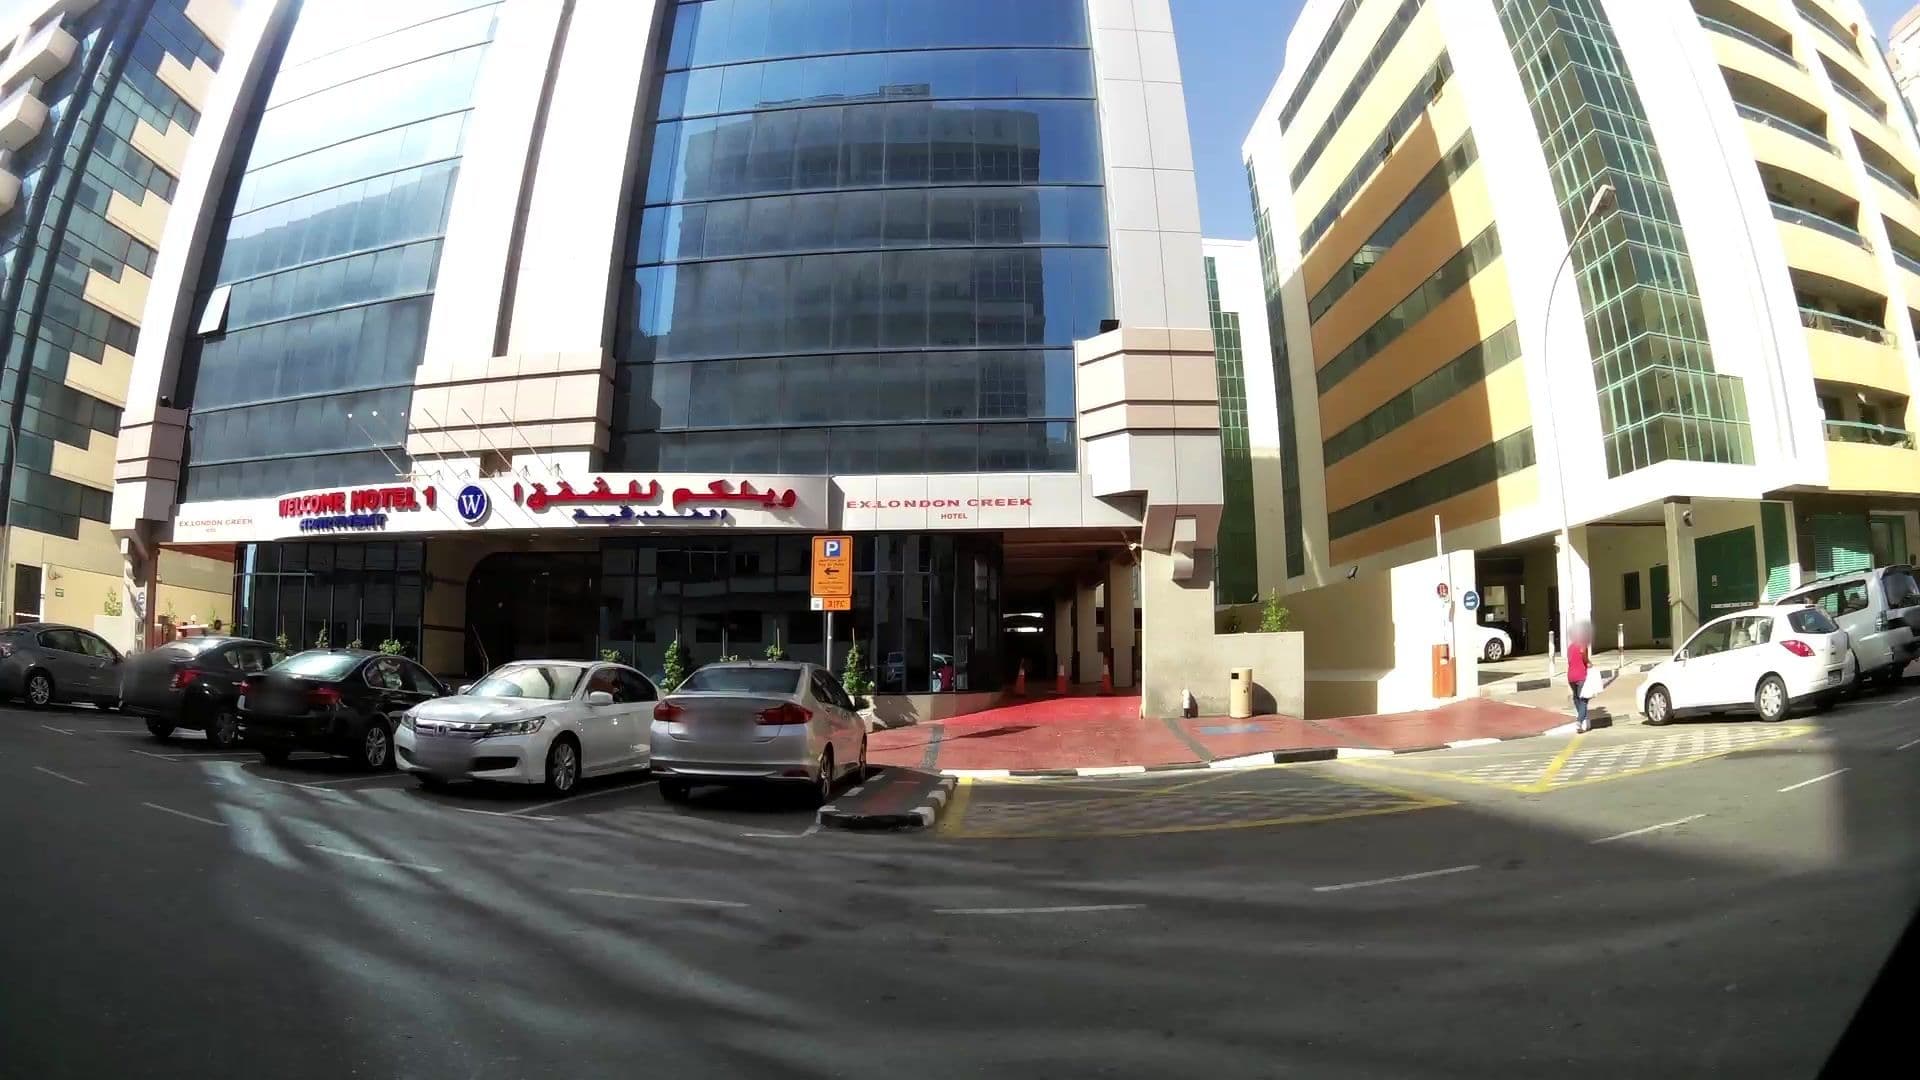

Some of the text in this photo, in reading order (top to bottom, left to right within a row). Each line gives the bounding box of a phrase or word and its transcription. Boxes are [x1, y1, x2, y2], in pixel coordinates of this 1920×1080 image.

[279, 486, 437, 516] WELCOME HOTEL 1
[462, 494, 485, 514] W
[966, 498, 1032, 506] CREEK
[826, 541, 838, 556] P
